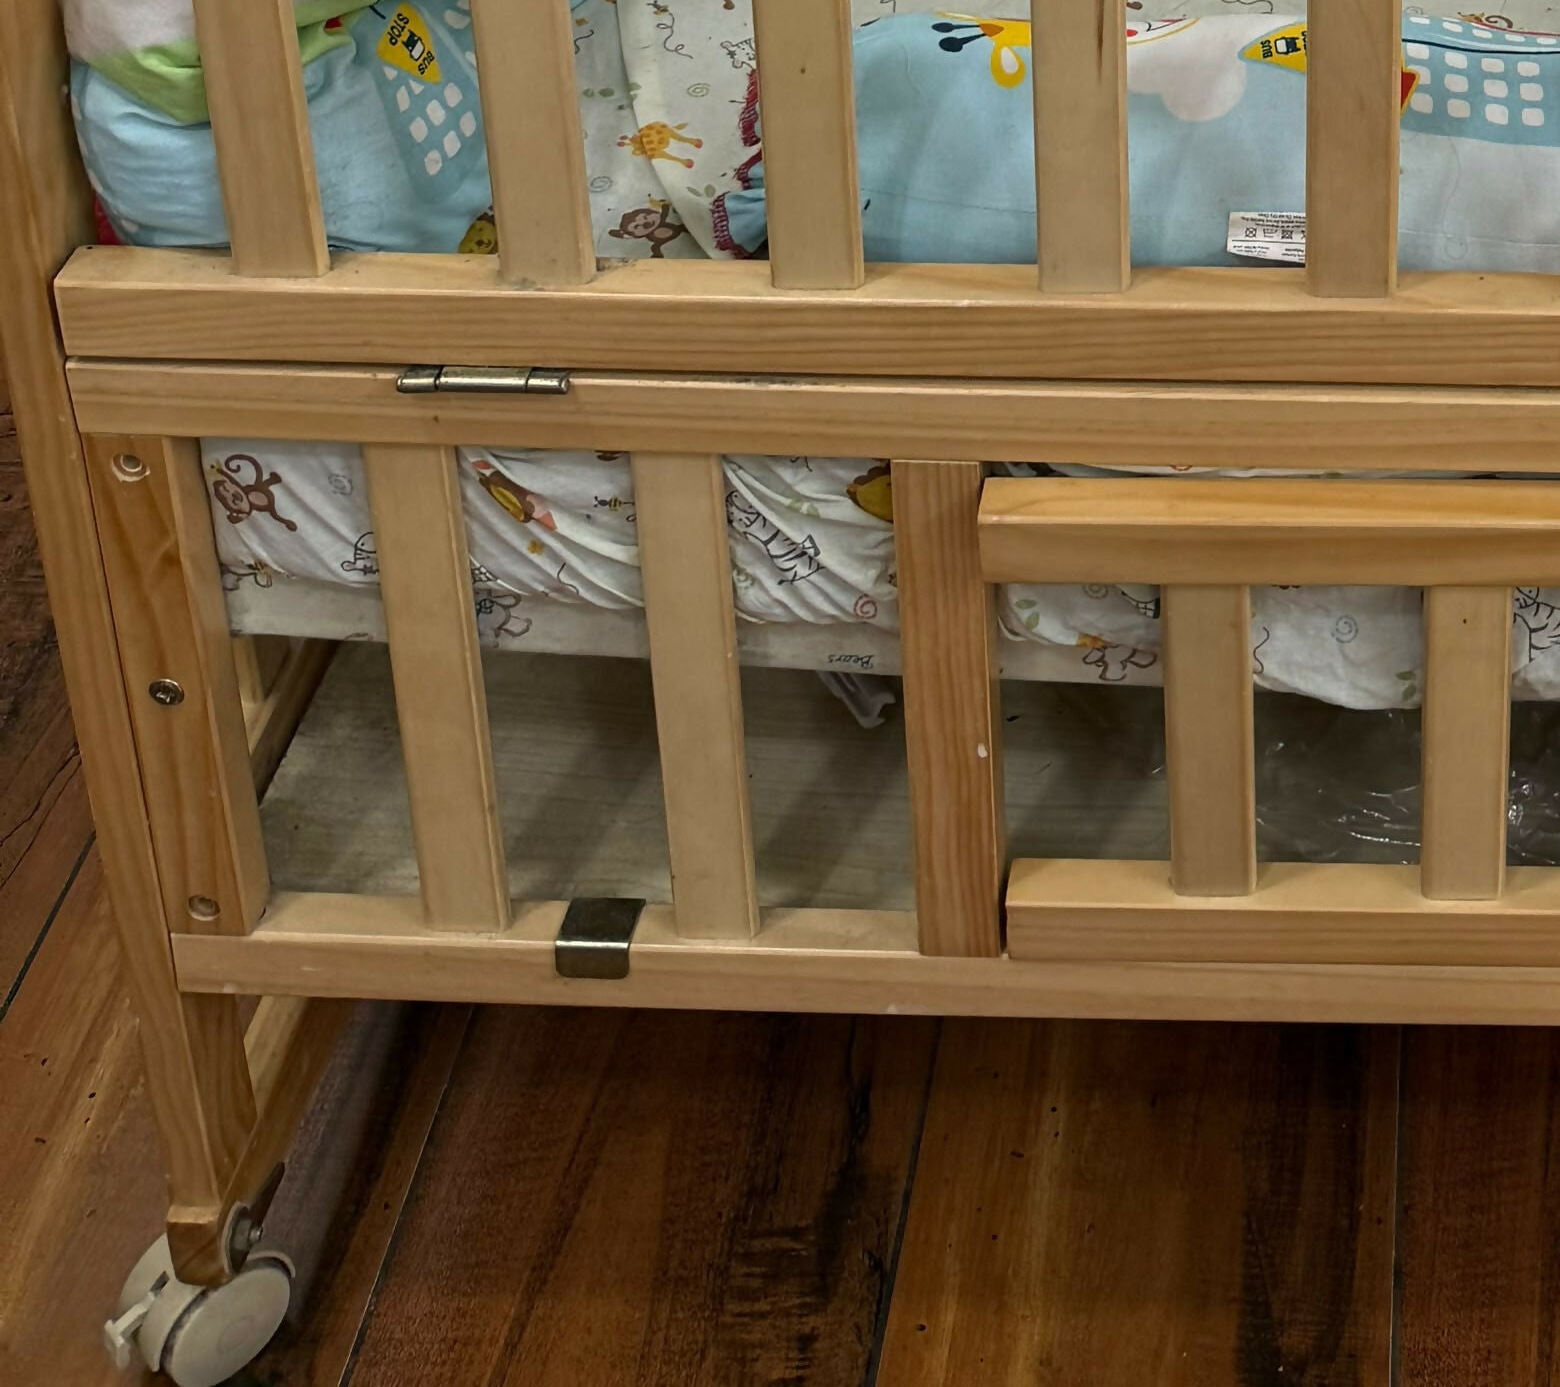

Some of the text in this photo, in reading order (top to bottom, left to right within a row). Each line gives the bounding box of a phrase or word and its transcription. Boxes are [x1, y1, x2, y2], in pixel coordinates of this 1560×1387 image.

[387, 13, 409, 46] STOP
[1260, 39, 1273, 59] BUS
[418, 50, 435, 75] BUS
[827, 654, 875, 669] Bears
